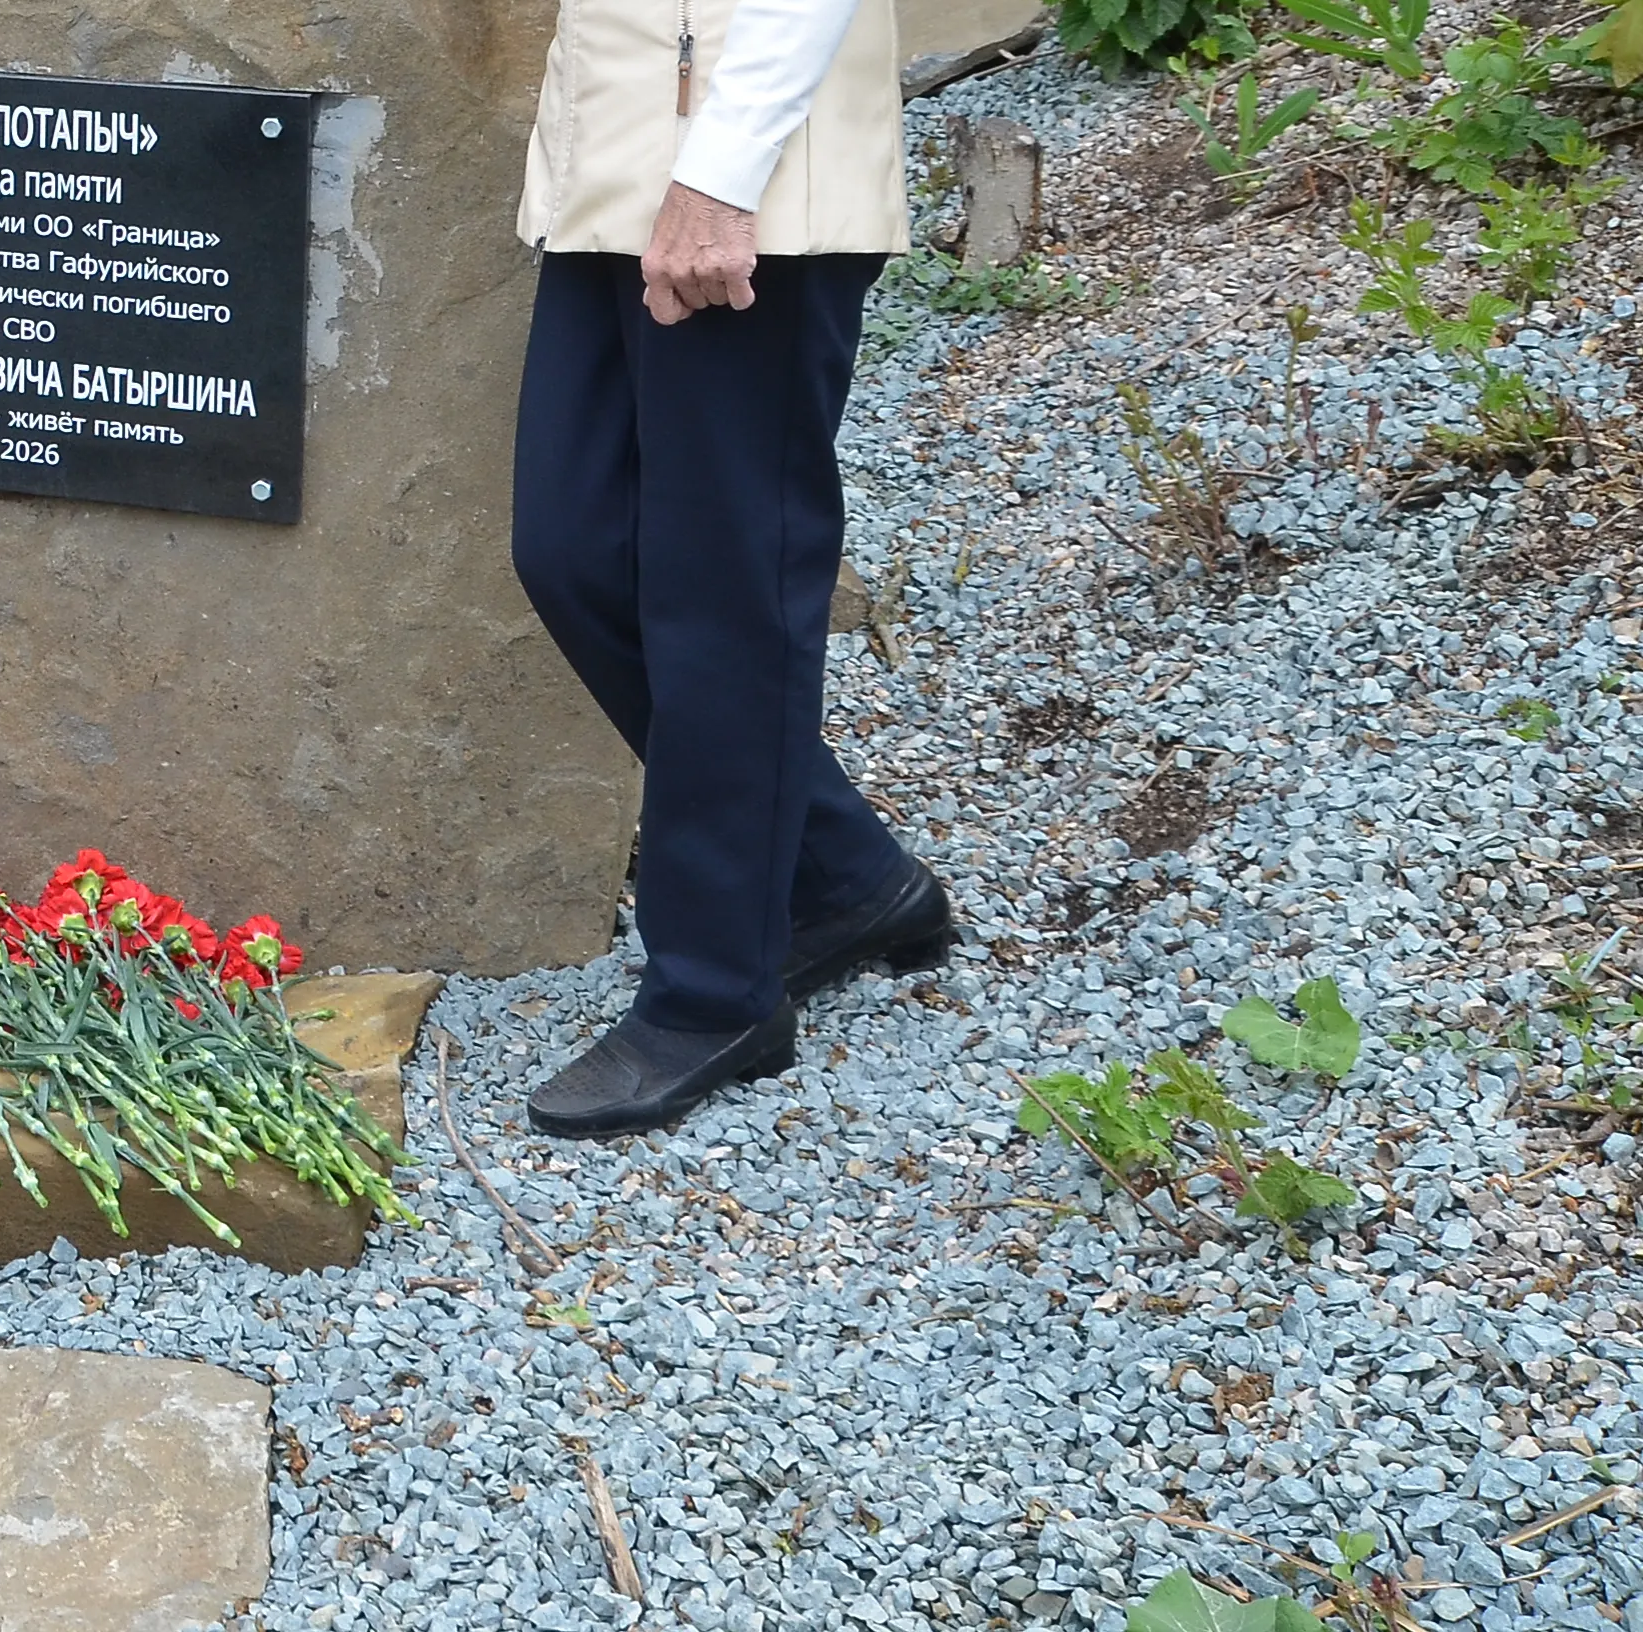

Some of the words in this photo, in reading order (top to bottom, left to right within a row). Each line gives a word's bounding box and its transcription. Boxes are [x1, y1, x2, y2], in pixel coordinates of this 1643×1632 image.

[24, 170, 122, 204] памяти
[33, 213, 74, 238] ОО
[81, 218, 221, 251] «Граница»
[49, 250, 230, 287] Гафурийского
[92, 294, 231, 324] погибшего
[2, 317, 56, 343] СВО
[72, 363, 257, 418] БАТЫРШИНА
[7, 410, 87, 435] живёт
[93, 419, 184, 445] память
[0, 438, 60, 466] 2026
